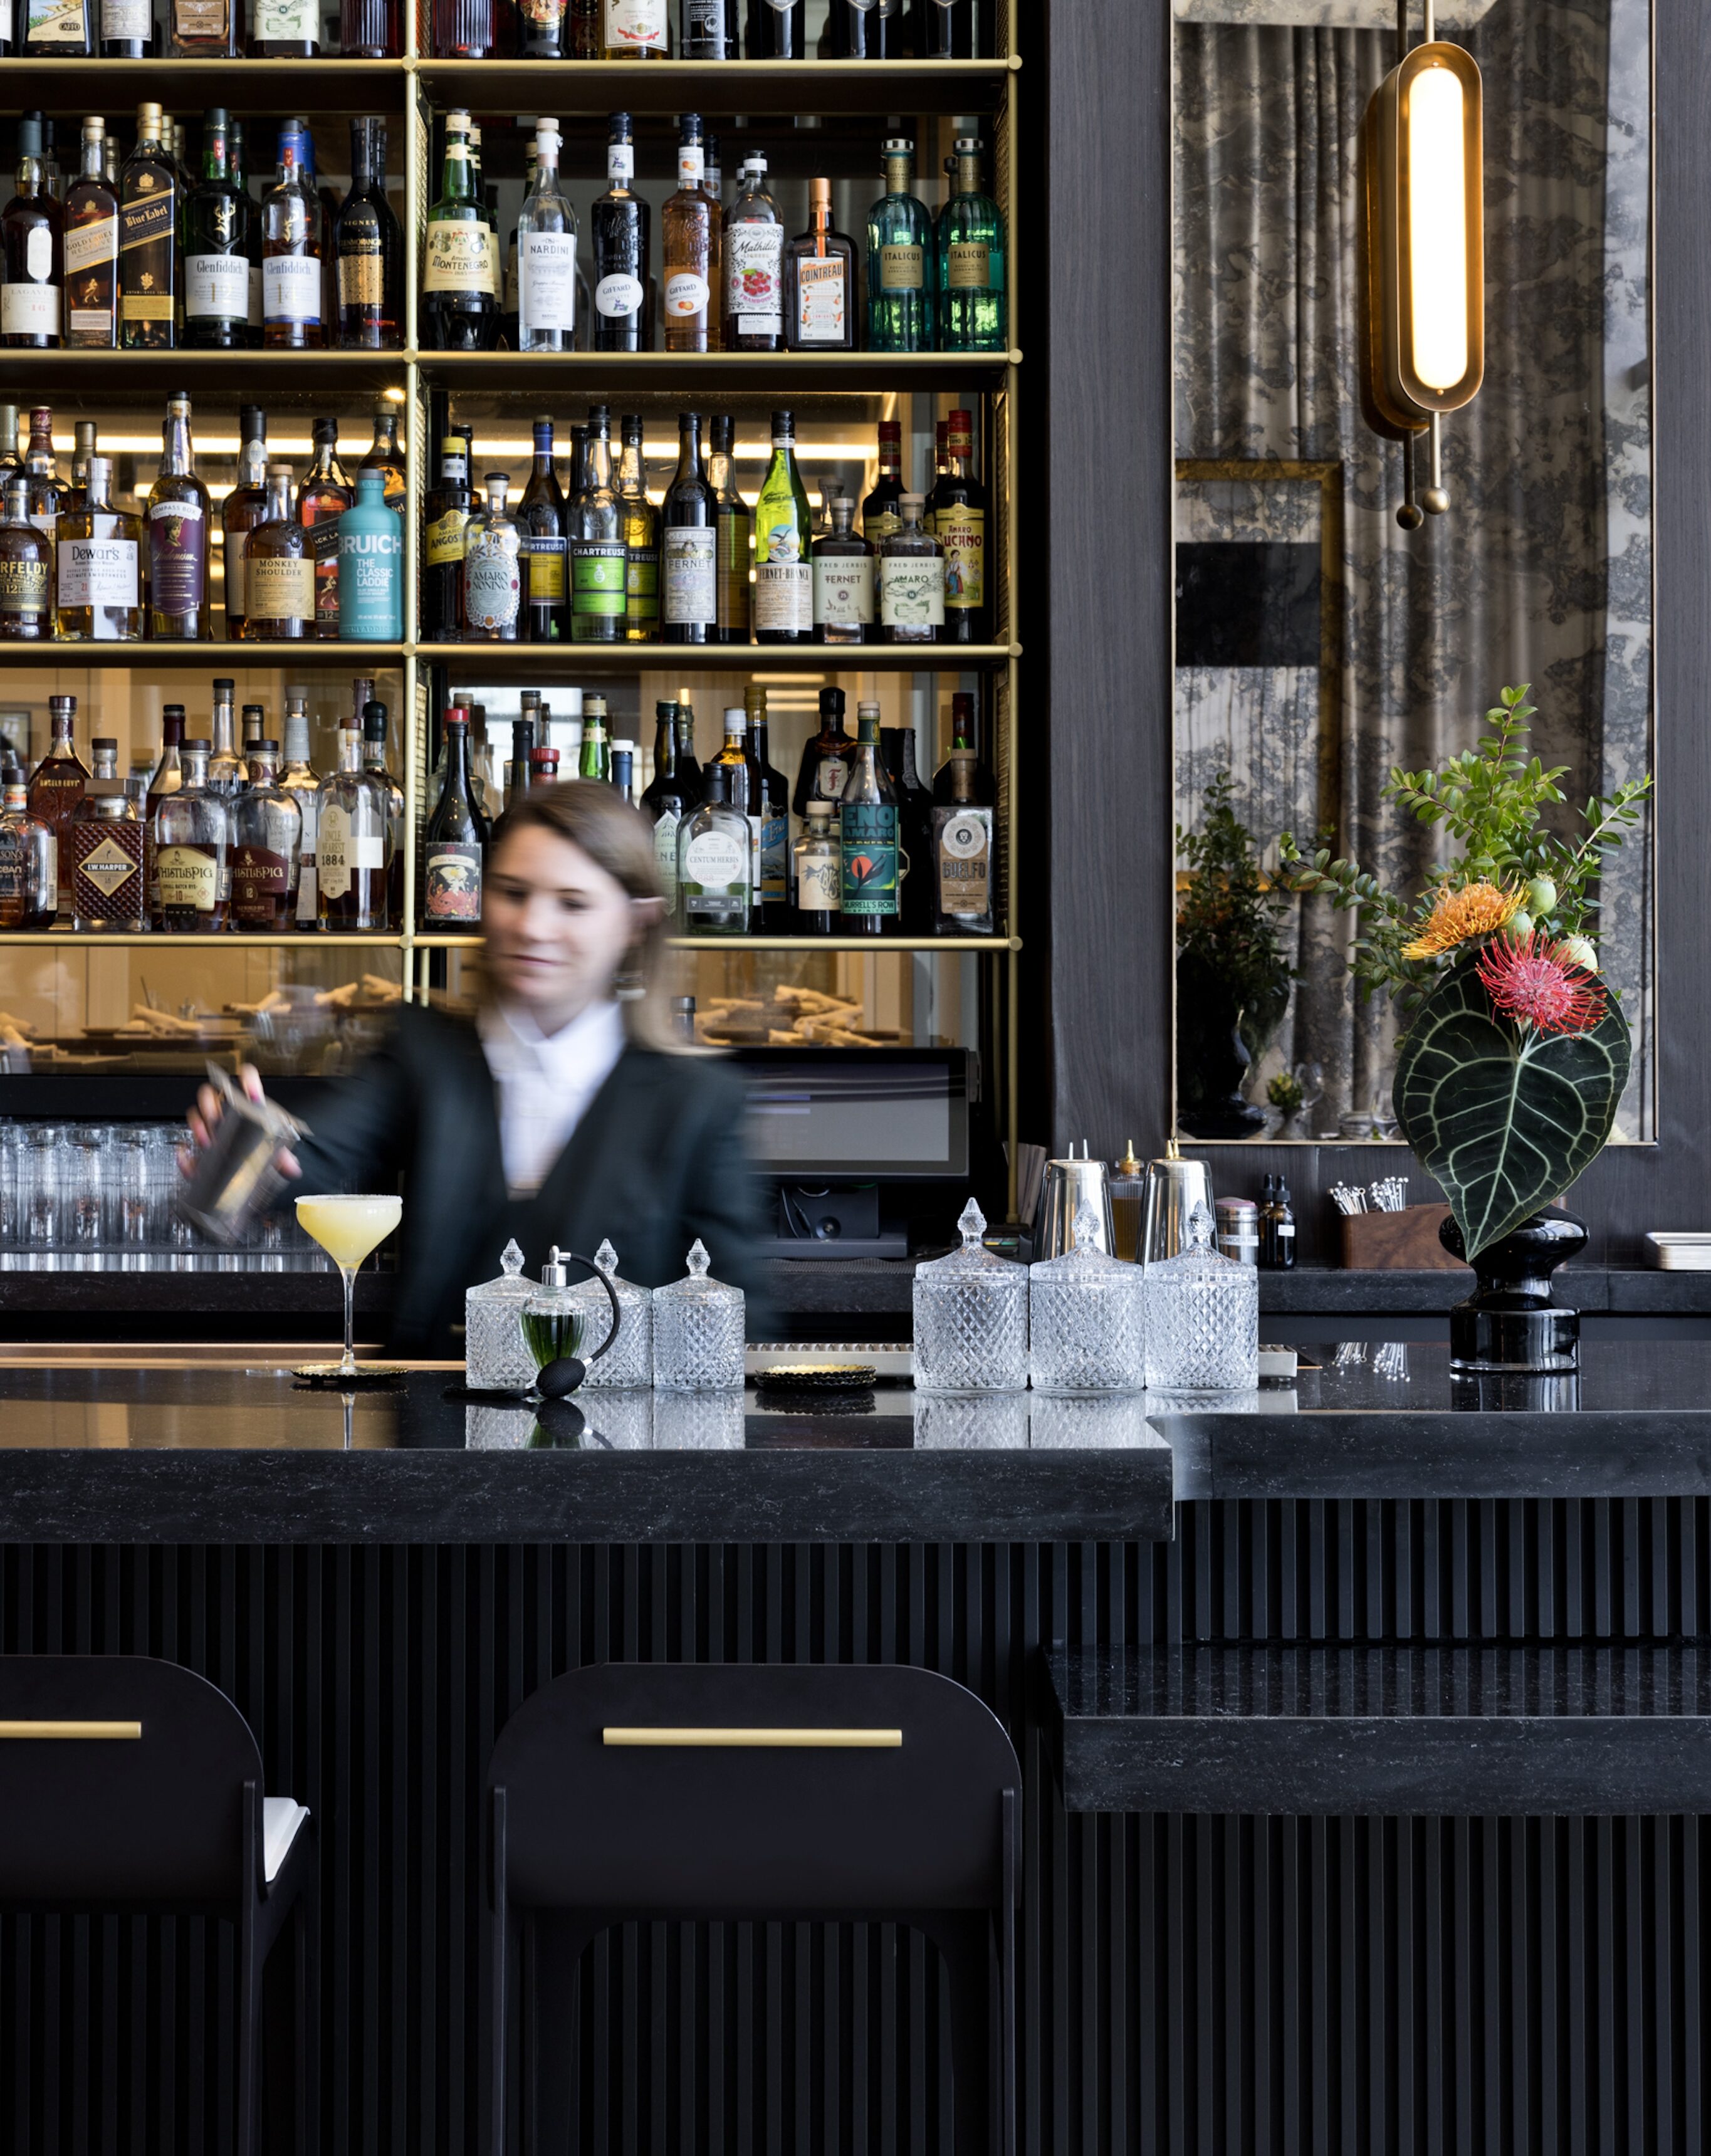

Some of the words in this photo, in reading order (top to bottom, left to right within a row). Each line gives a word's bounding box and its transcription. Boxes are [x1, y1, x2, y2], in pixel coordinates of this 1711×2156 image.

[125, 214, 145, 228] Blue
[144, 205, 169, 224] Label
[66, 239, 88, 251] GOLD
[88, 231, 113, 243] LABEL
[530, 245, 568, 255] NARDINI
[733, 240, 777, 256] Mathilde
[885, 252, 920, 261] ITALICUS
[951, 251, 986, 259] ITALICUS
[197, 259, 243, 275] Glenfiddich
[432, 255, 488, 270] MONTENEGRO
[266, 261, 311, 276] Glenfiddich
[801, 263, 842, 283] COINTREAU
[602, 284, 631, 295] GIFFARD
[669, 283, 696, 295] GIFFARD
[740, 292, 773, 305] FRAMBOISE
[152, 505, 181, 516] COMPASS
[182, 506, 197, 516] BOX
[71, 546, 120, 561] Dewar's
[573, 548, 625, 557] CHARTREUSE
[259, 560, 298, 568] MONKEY
[357, 558, 375, 568] THE
[667, 560, 711, 569] FERNET
[255, 568, 302, 576] SHOULDER
[357, 568, 394, 578] CLASSIC
[473, 571, 508, 582] AMARO
[758, 567, 809, 580] FERNET-BRANCA
[357, 578, 389, 587] LADDIE
[825, 575, 861, 583] FERNET
[894, 575, 929, 583] AMARO
[5, 583, 19, 594] 12
[81, 582, 88, 592] 21
[472, 580, 508, 591] NONINO
[324, 611, 334, 619] 12
[844, 805, 894, 827] ENO
[844, 827, 894, 837] AMARO
[322, 854, 345, 866] 1884
[689, 856, 716, 864] CENTUM
[717, 856, 739, 864] HERBIS
[942, 861, 986, 879] GUELFO
[175, 891, 183, 901] 10
[246, 887, 253, 898] 12
